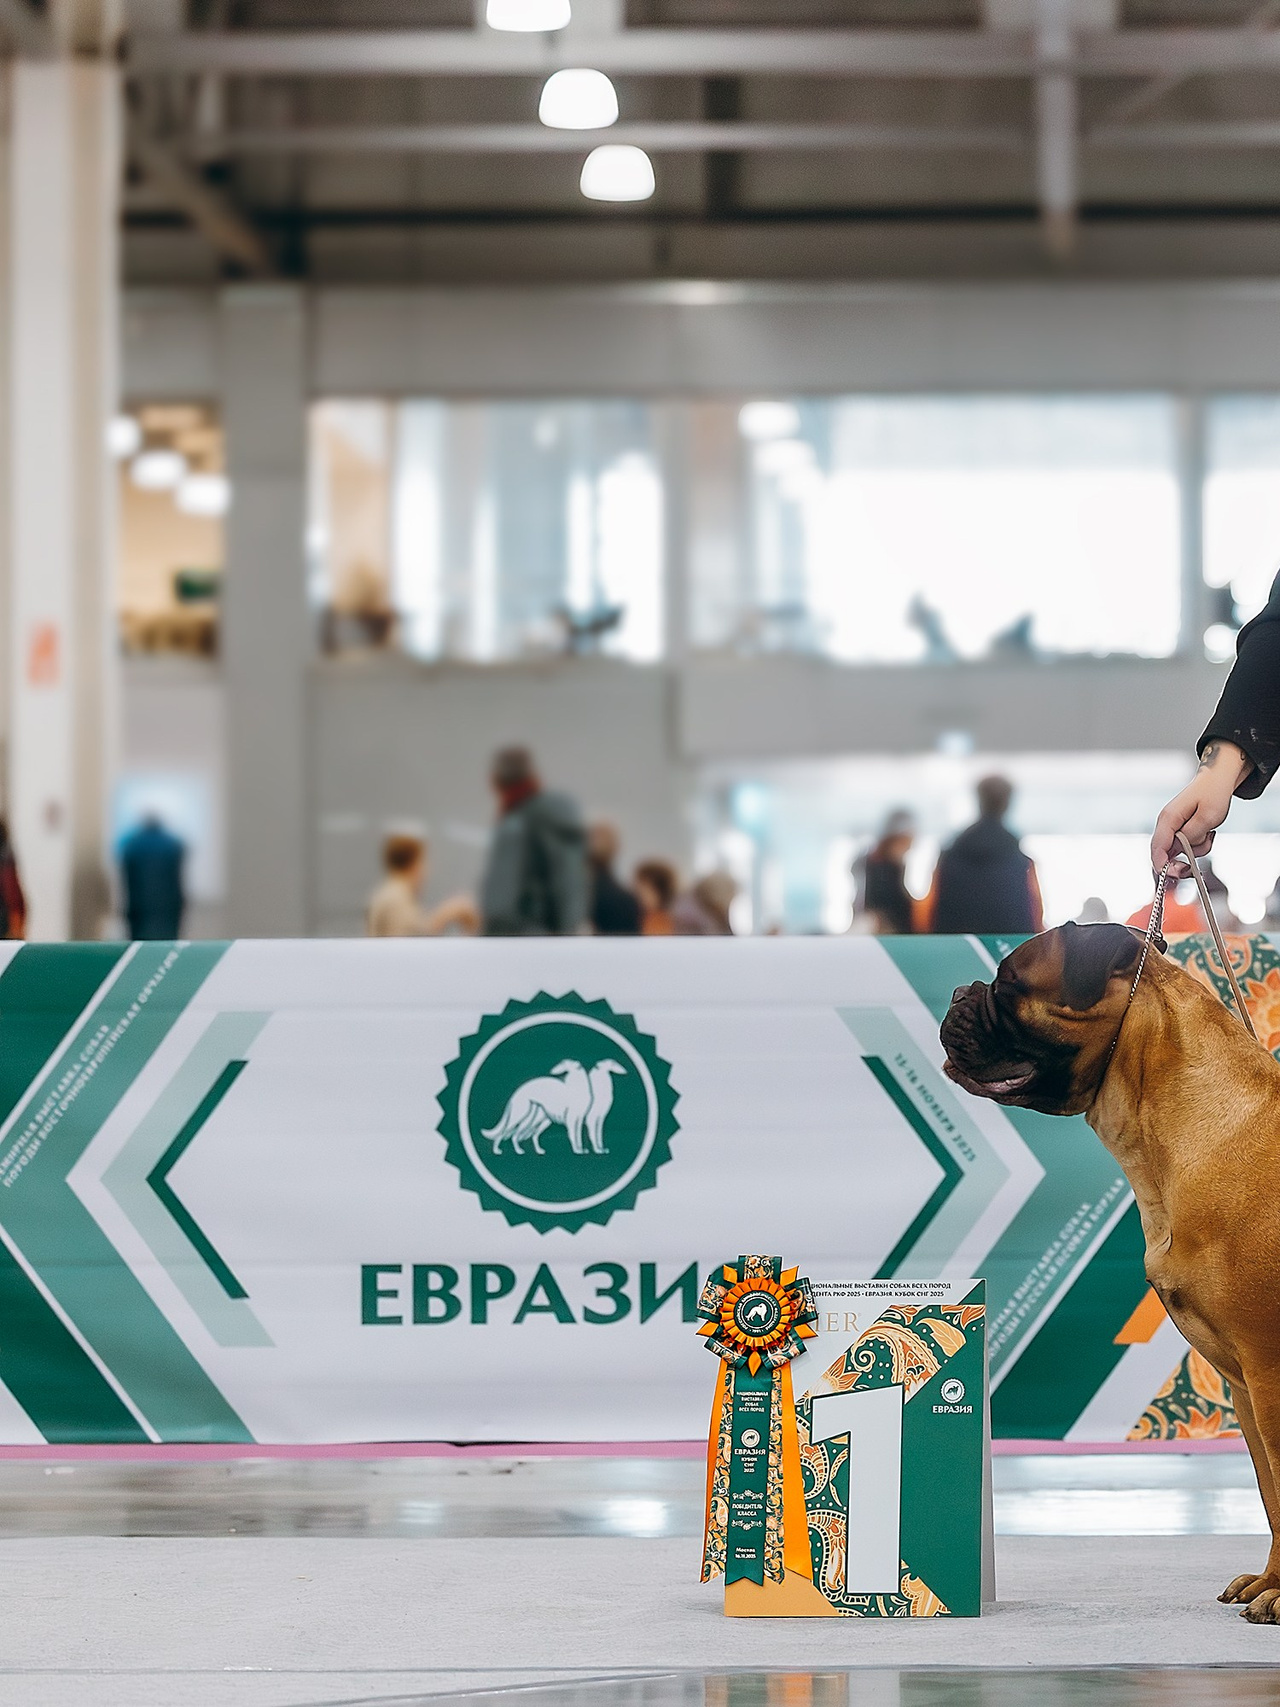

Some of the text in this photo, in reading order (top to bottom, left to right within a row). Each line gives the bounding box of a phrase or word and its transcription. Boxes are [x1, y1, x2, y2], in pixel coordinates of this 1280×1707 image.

[361, 1260, 736, 1325] ЕВРАЗИ
[932, 1405, 973, 1414] ЕВРАЗИЯ
[811, 1384, 904, 1594] 1
